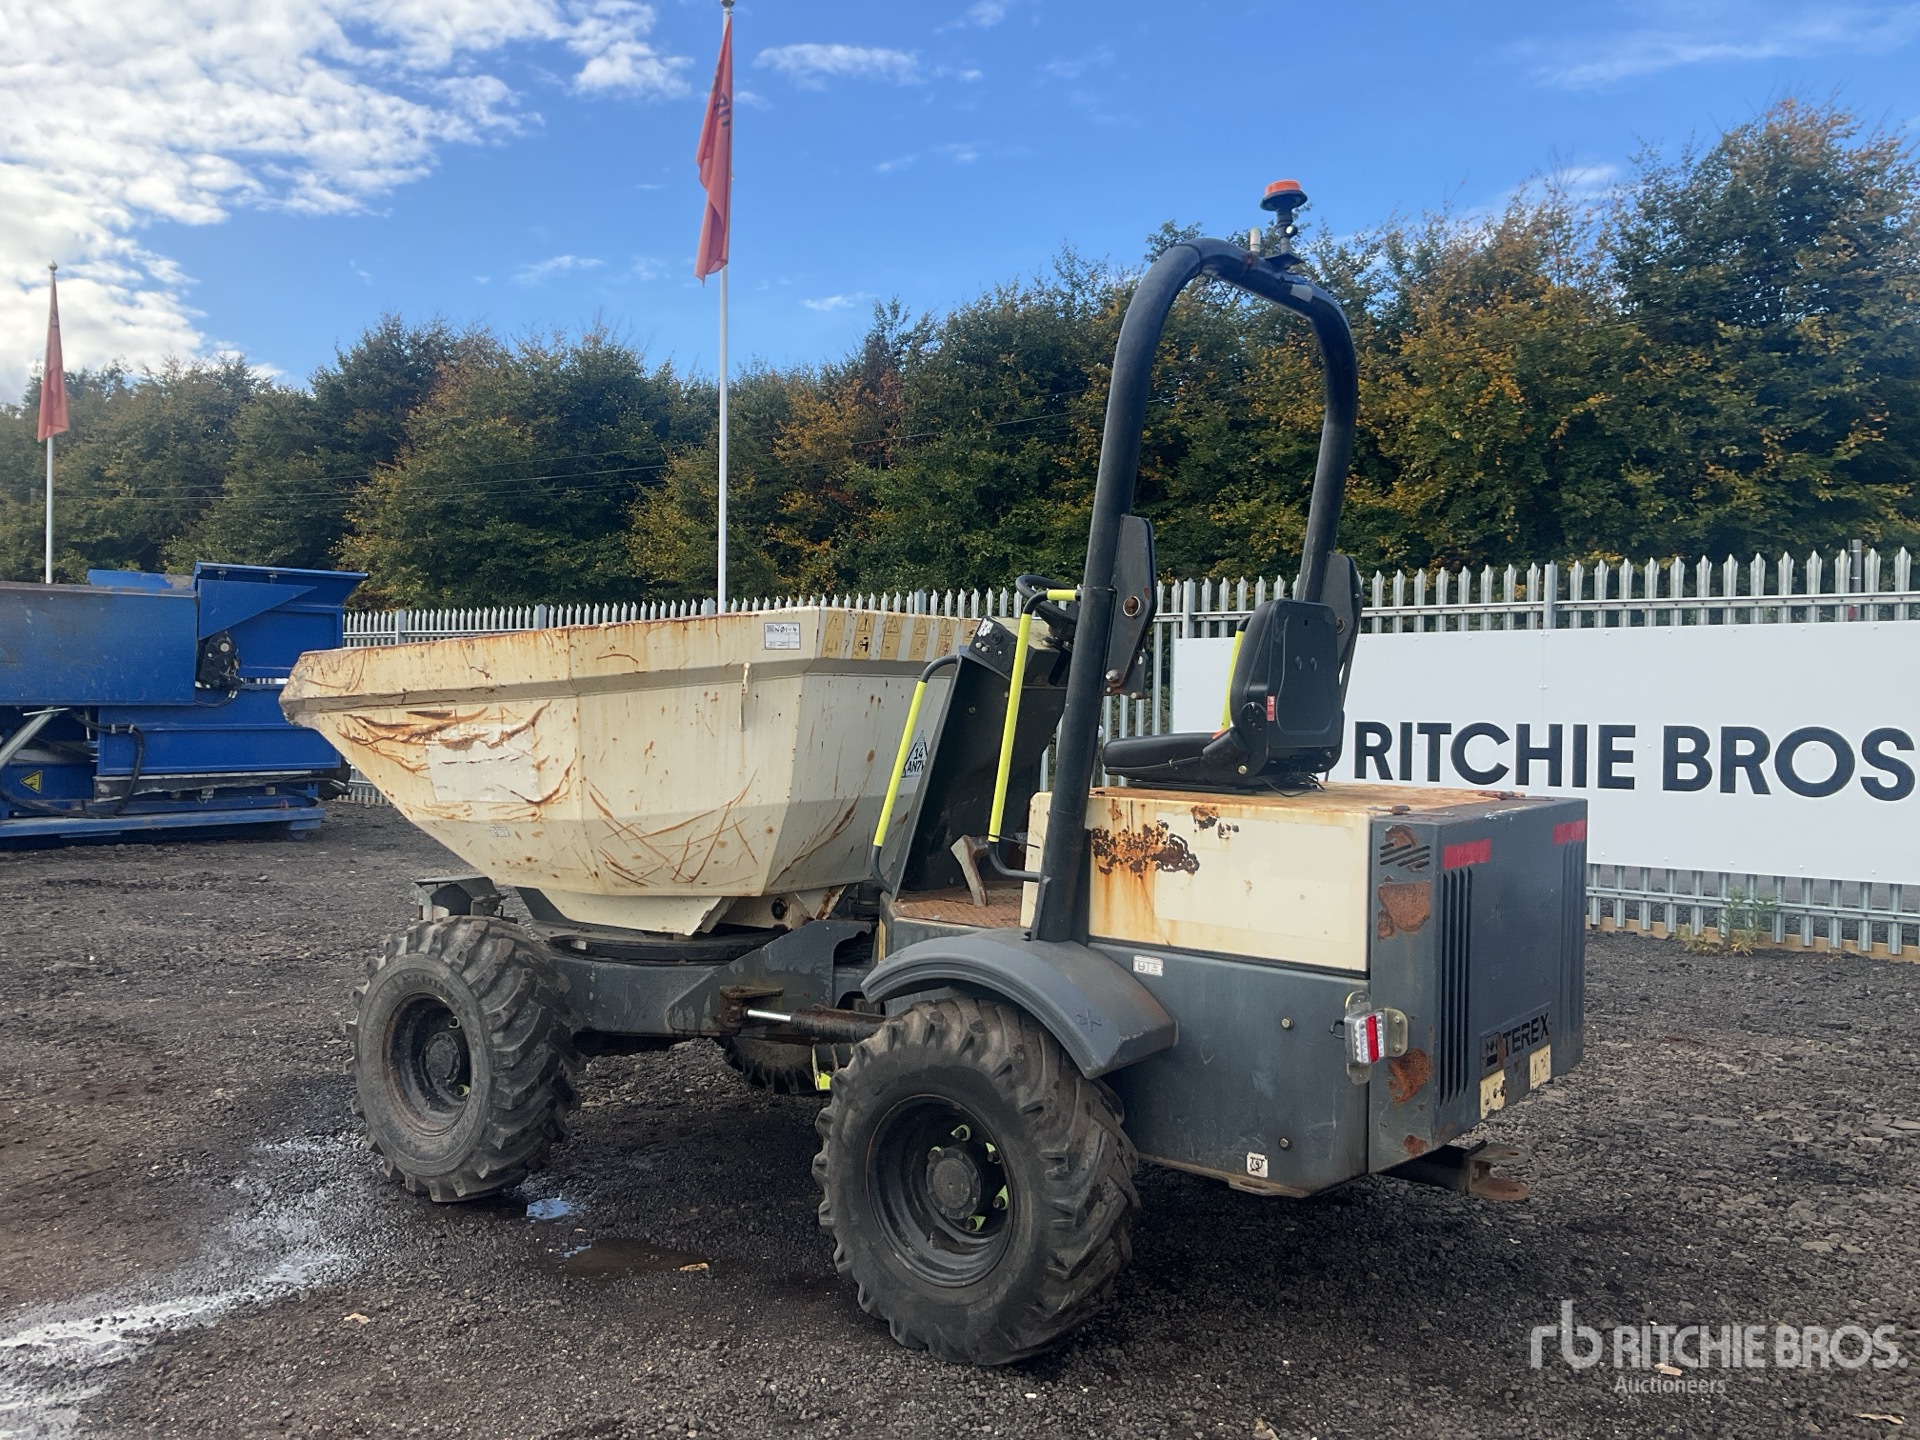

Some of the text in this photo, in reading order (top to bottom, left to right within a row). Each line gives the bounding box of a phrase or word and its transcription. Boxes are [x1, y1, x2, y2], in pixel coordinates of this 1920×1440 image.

[1353, 720, 1916, 802] RITCHIE BROS
[1502, 1012, 1549, 1058] TEREX
